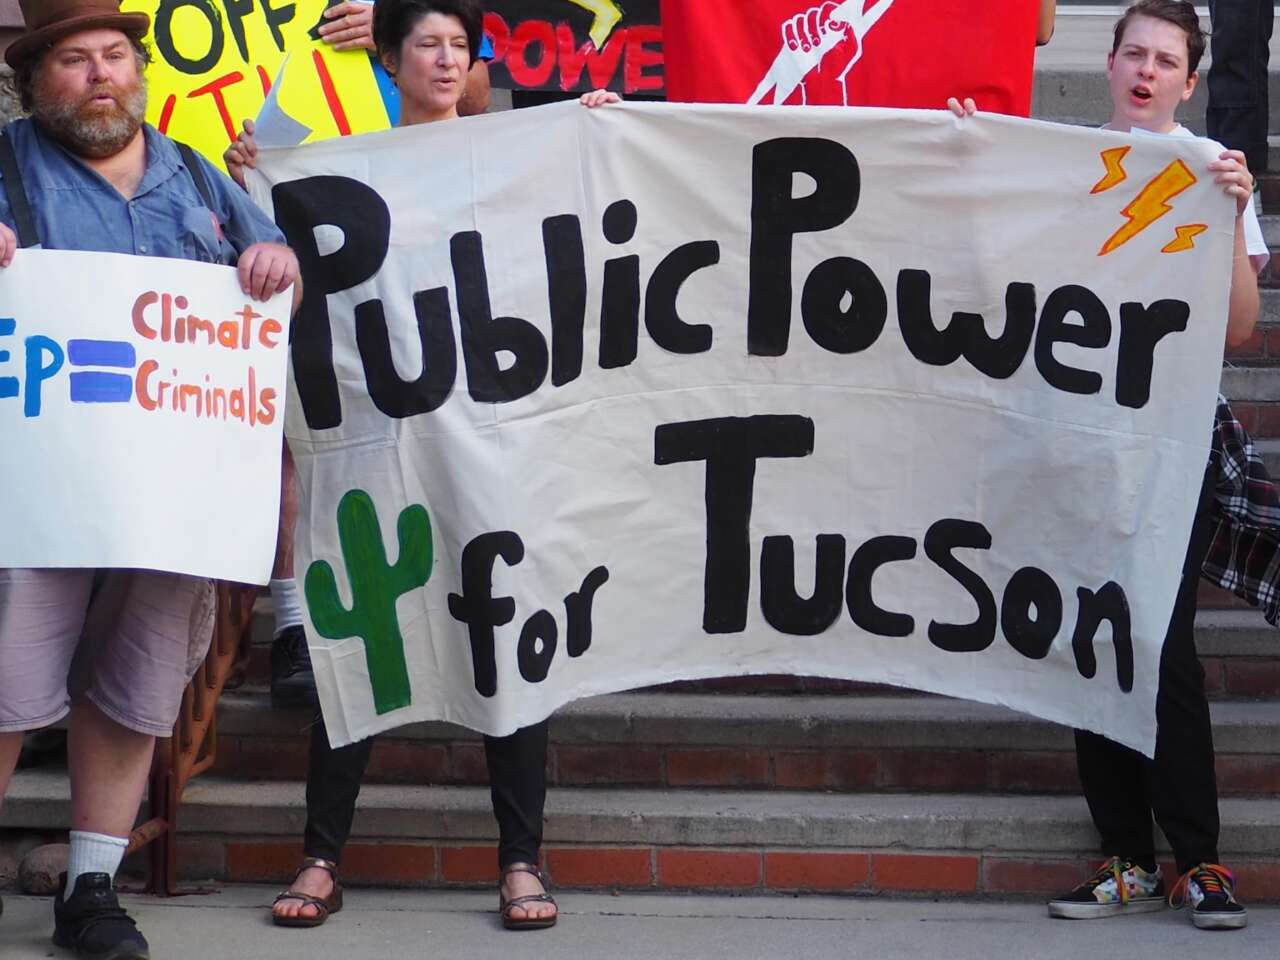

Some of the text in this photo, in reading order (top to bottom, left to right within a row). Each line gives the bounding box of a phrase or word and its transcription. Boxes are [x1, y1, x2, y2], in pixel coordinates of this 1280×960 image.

[482, 11, 665, 94] POWE
[131, 290, 283, 351] Climate
[272, 137, 1191, 430] Public Power
[135, 359, 277, 428] Criminals
[448, 530, 608, 698] for
